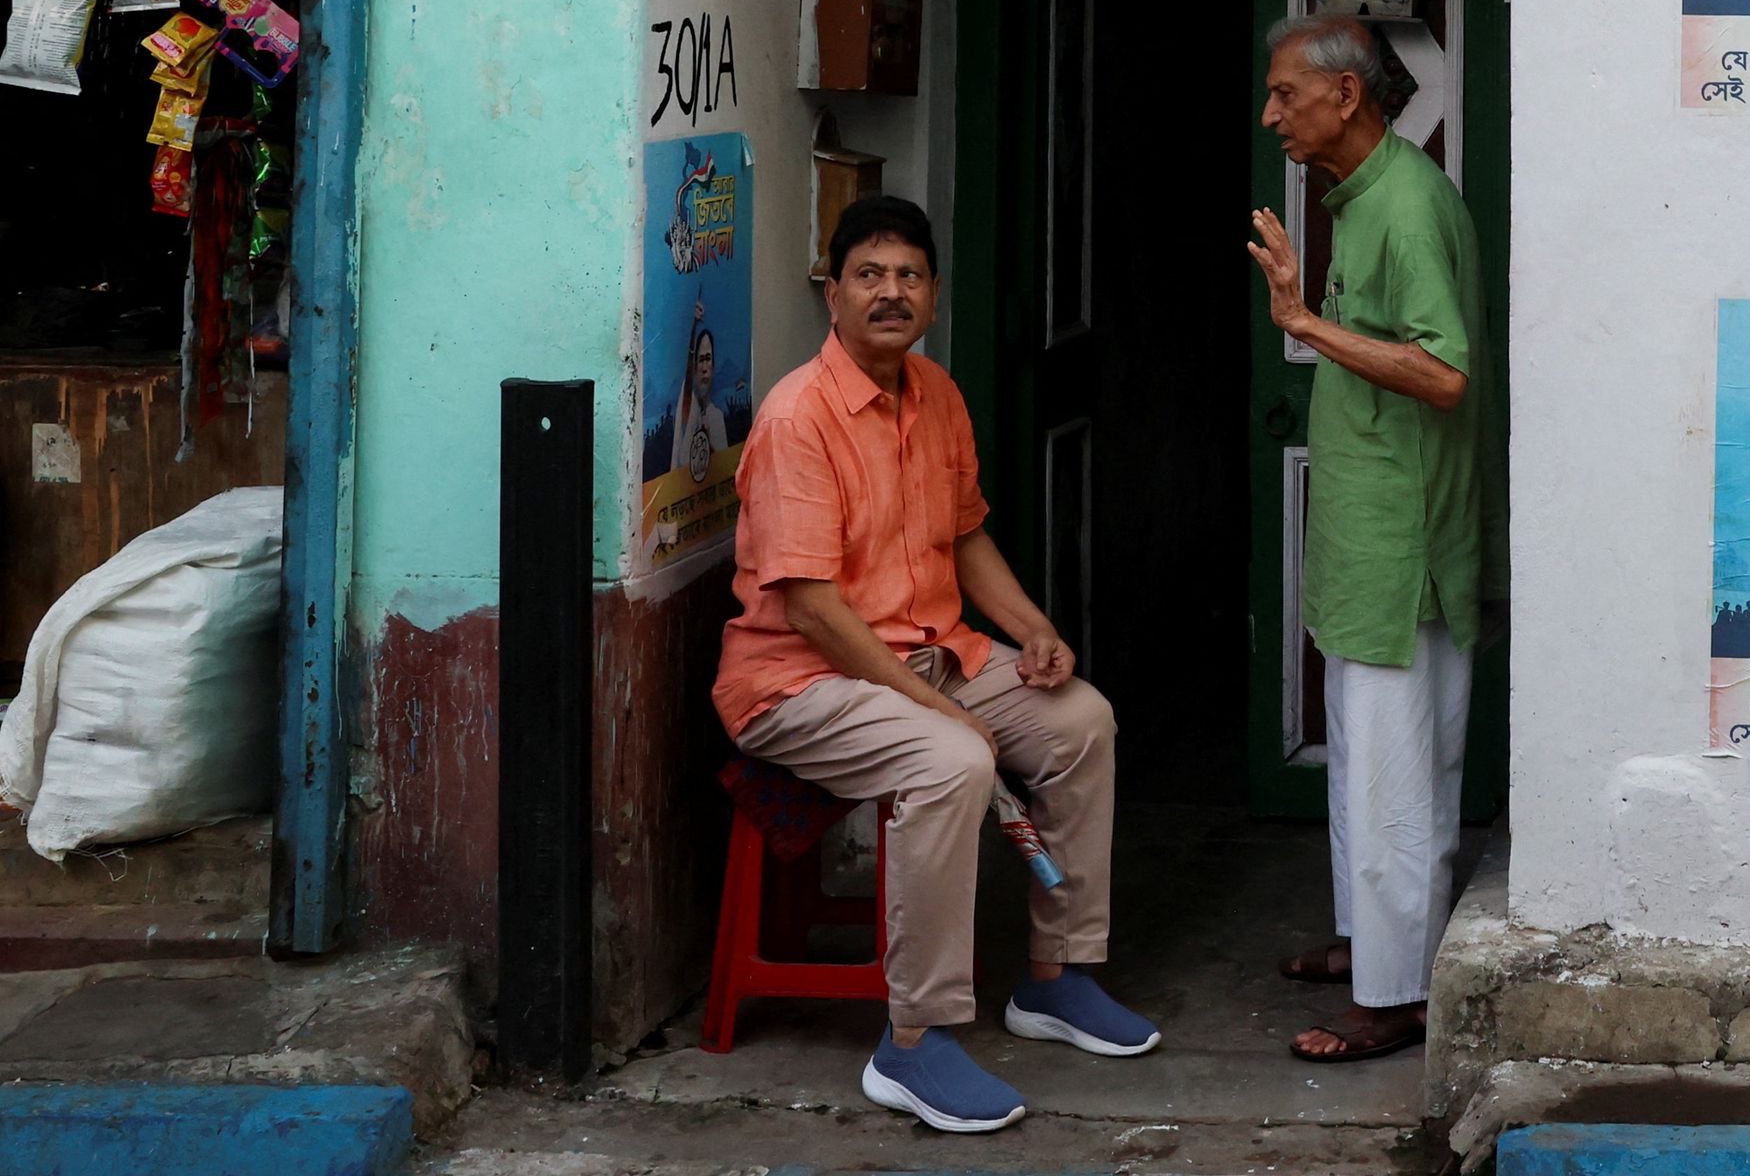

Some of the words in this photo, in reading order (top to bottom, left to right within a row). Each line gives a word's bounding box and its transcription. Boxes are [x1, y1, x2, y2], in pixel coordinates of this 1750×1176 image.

[1722, 51, 1748, 71] যে
[1701, 76, 1746, 103] সেই
[694, 188, 735, 231] জিতবে
[693, 226, 735, 267] বাংলা
